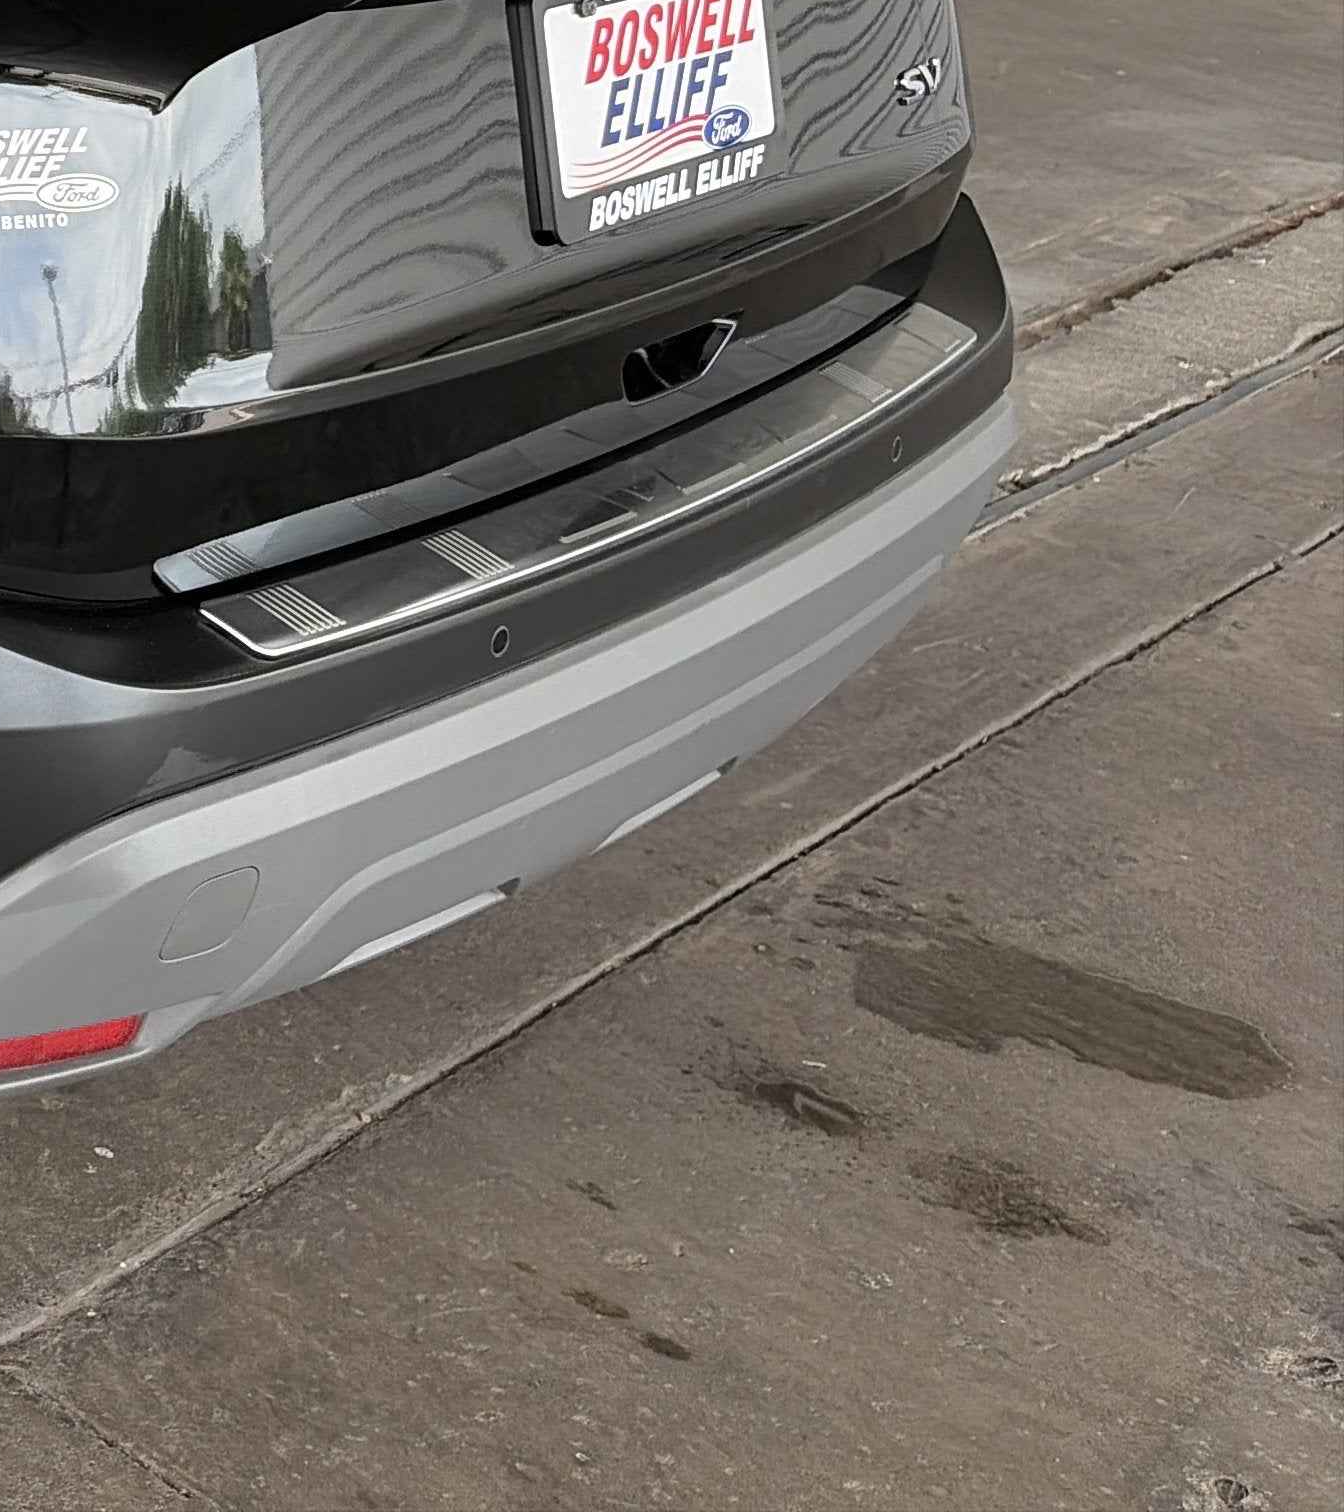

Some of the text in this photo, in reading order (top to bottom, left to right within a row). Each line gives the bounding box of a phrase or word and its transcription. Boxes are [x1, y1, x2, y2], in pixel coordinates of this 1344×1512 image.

[600, 50, 733, 148] ELLIFF
[895, 58, 941, 106] SV
[712, 112, 742, 144] Ford
[53, 183, 100, 203] Ford
[589, 144, 765, 232] BOSWELL ELLIFF
[1, 212, 69, 232] BENITO
